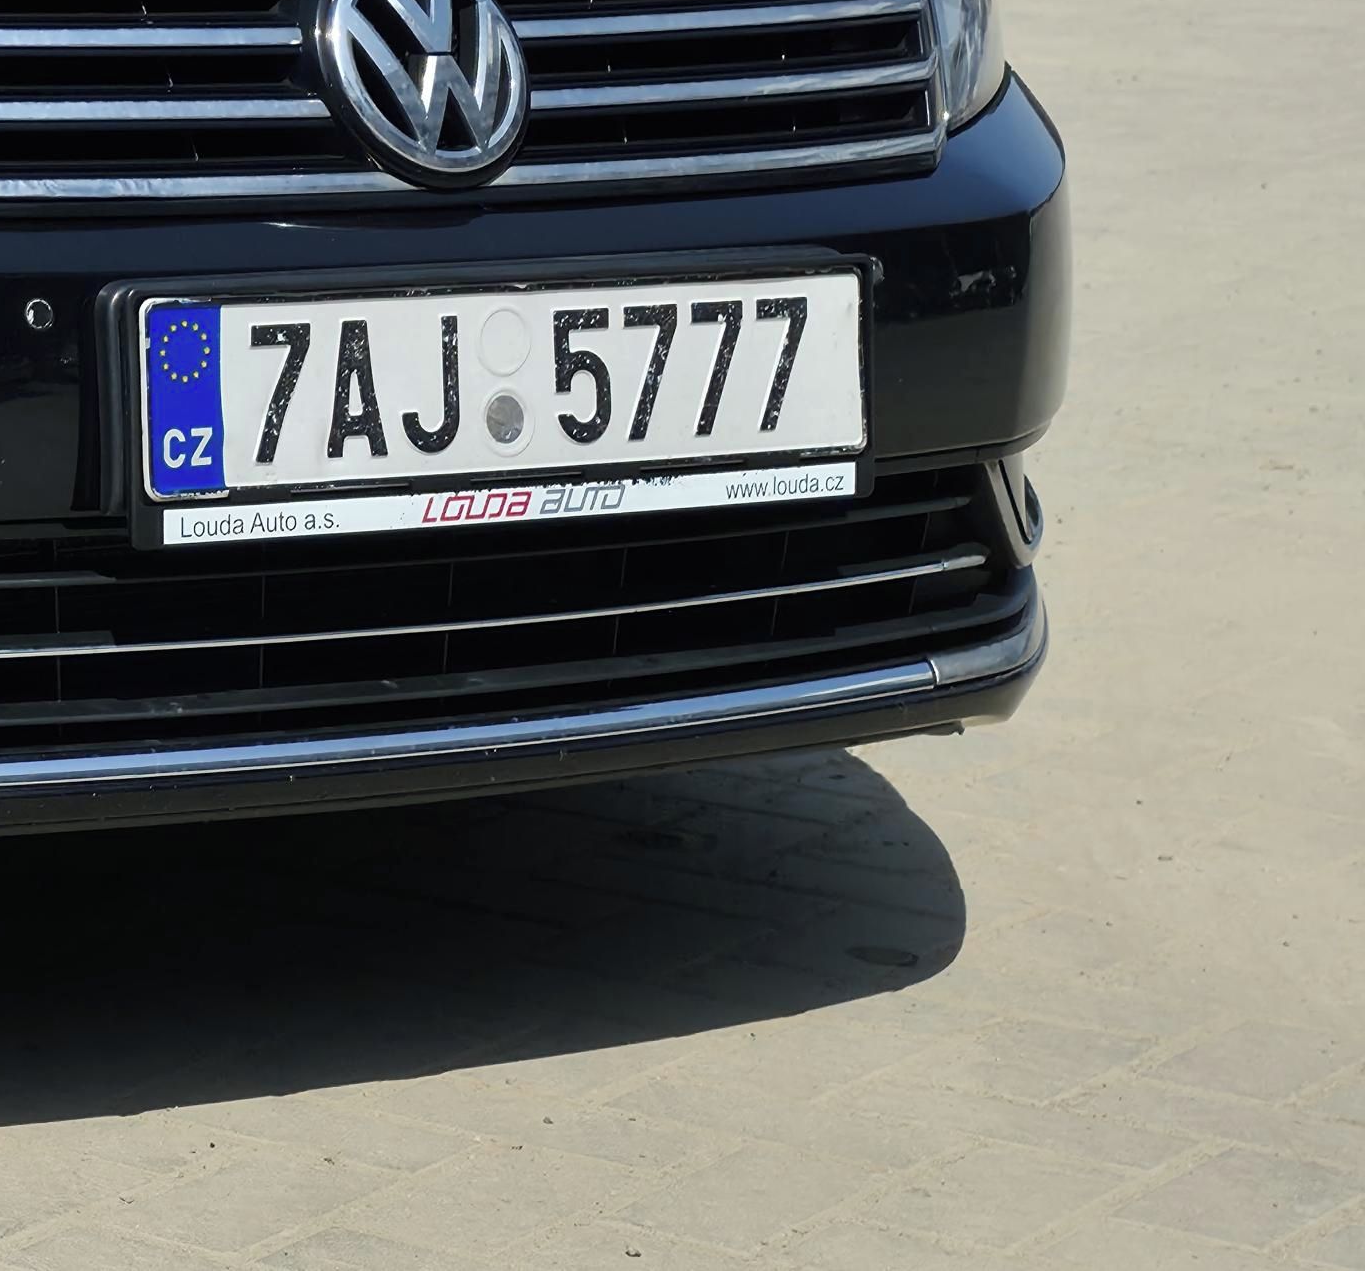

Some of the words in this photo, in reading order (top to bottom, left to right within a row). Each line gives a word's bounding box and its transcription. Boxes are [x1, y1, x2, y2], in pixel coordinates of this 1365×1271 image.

[250, 315, 460, 464] 7AJ
[552, 296, 808, 446] 5777
[163, 427, 213, 469] CZ
[725, 473, 845, 500] www.louda.cz
[180, 513, 245, 539] Louda
[250, 511, 297, 534] Auto
[304, 512, 340, 530] a.s.
